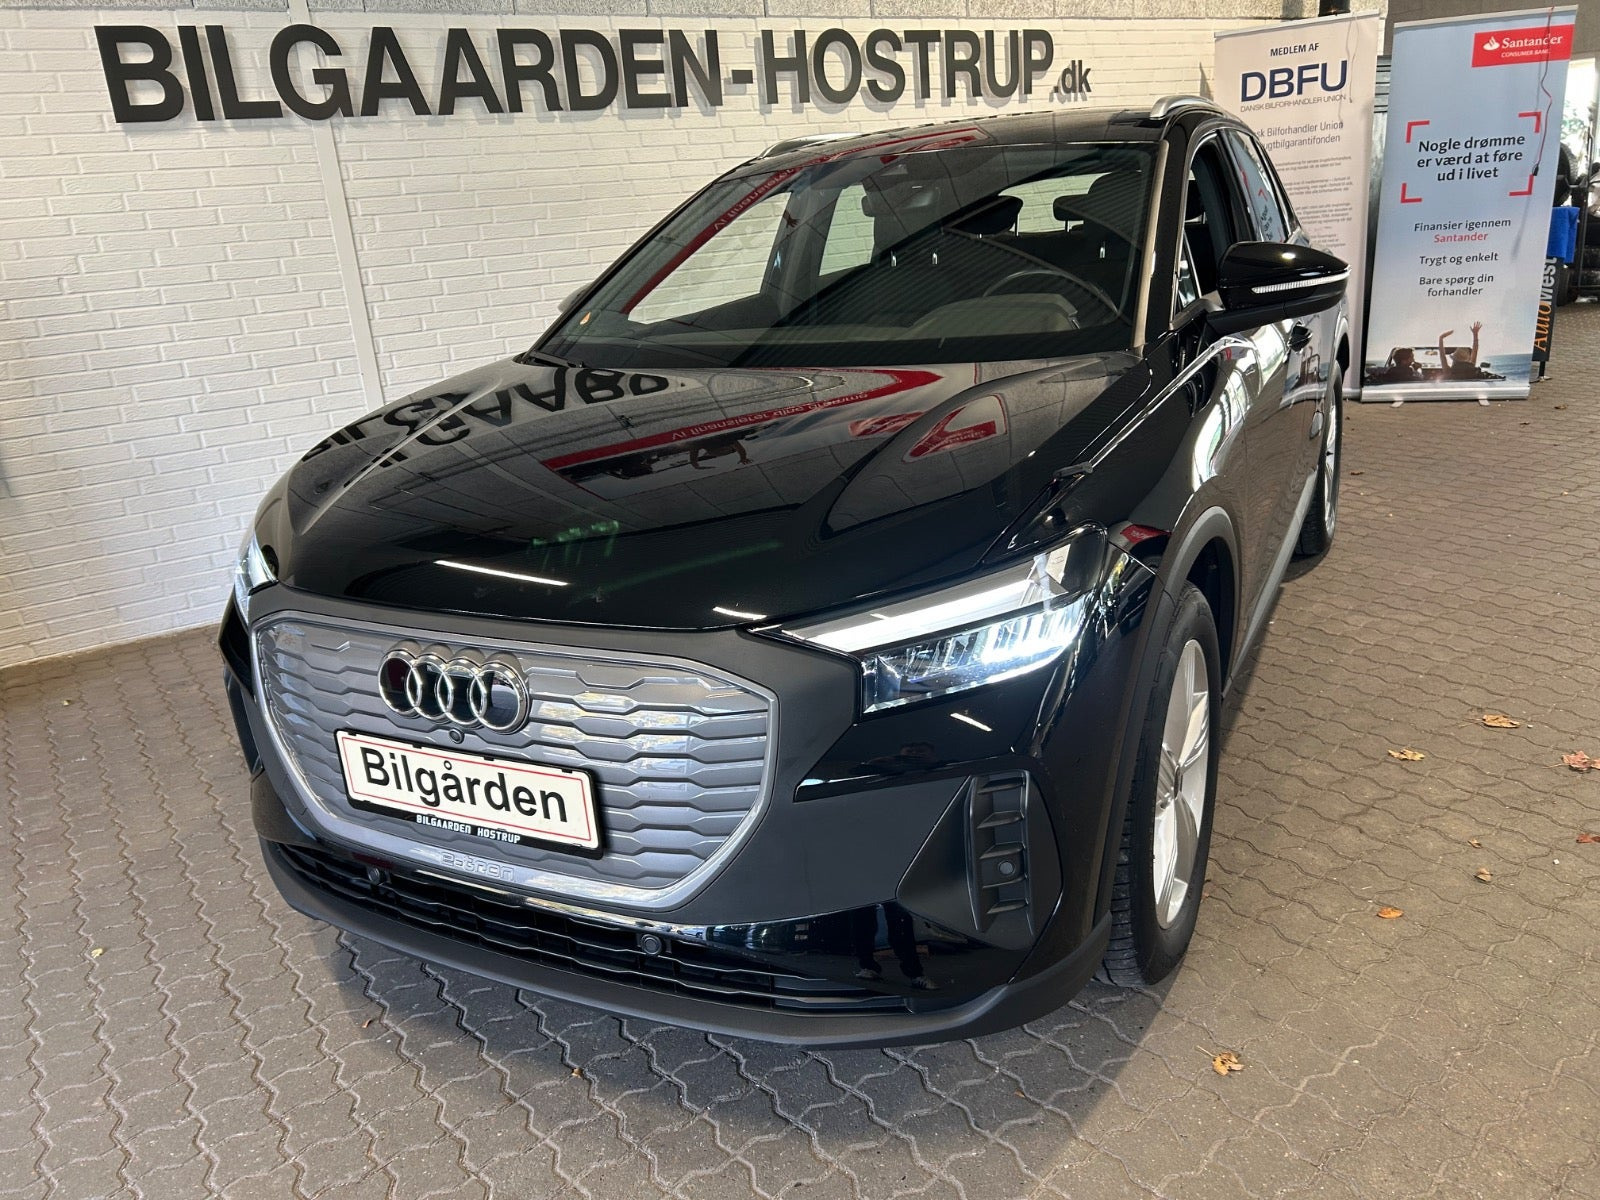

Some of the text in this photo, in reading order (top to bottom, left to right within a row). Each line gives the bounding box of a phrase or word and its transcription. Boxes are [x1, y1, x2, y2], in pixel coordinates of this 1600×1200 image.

[1502, 33, 1563, 49] Santander
[1270, 43, 1320, 56] MEDLEM AF
[1501, 50, 1533, 58] CONSUMER
[1241, 60, 1347, 102] DBFU
[1240, 94, 1347, 112] DANSK BILFORHANDLER UNION
[1267, 123, 1317, 137] Bilforhandler
[1320, 120, 1343, 131] Union
[1264, 134, 1341, 151] ugtbilgarantifonden
[1418, 135, 1525, 154] Nogle drømme
[1417, 150, 1523, 168] er værd at føre
[1437, 166, 1498, 181] ud i livet
[1414, 219, 1511, 232] Finansier igennem
[1434, 232, 1489, 243] Santander
[1419, 252, 1499, 267] Trygt og enkelt
[1419, 274, 1494, 286] Bare spørg din
[1427, 286, 1484, 297] forhandler
[360, 746, 568, 822] Bilgården
[416, 814, 521, 844] BILGAARDEN HOSTRUP
